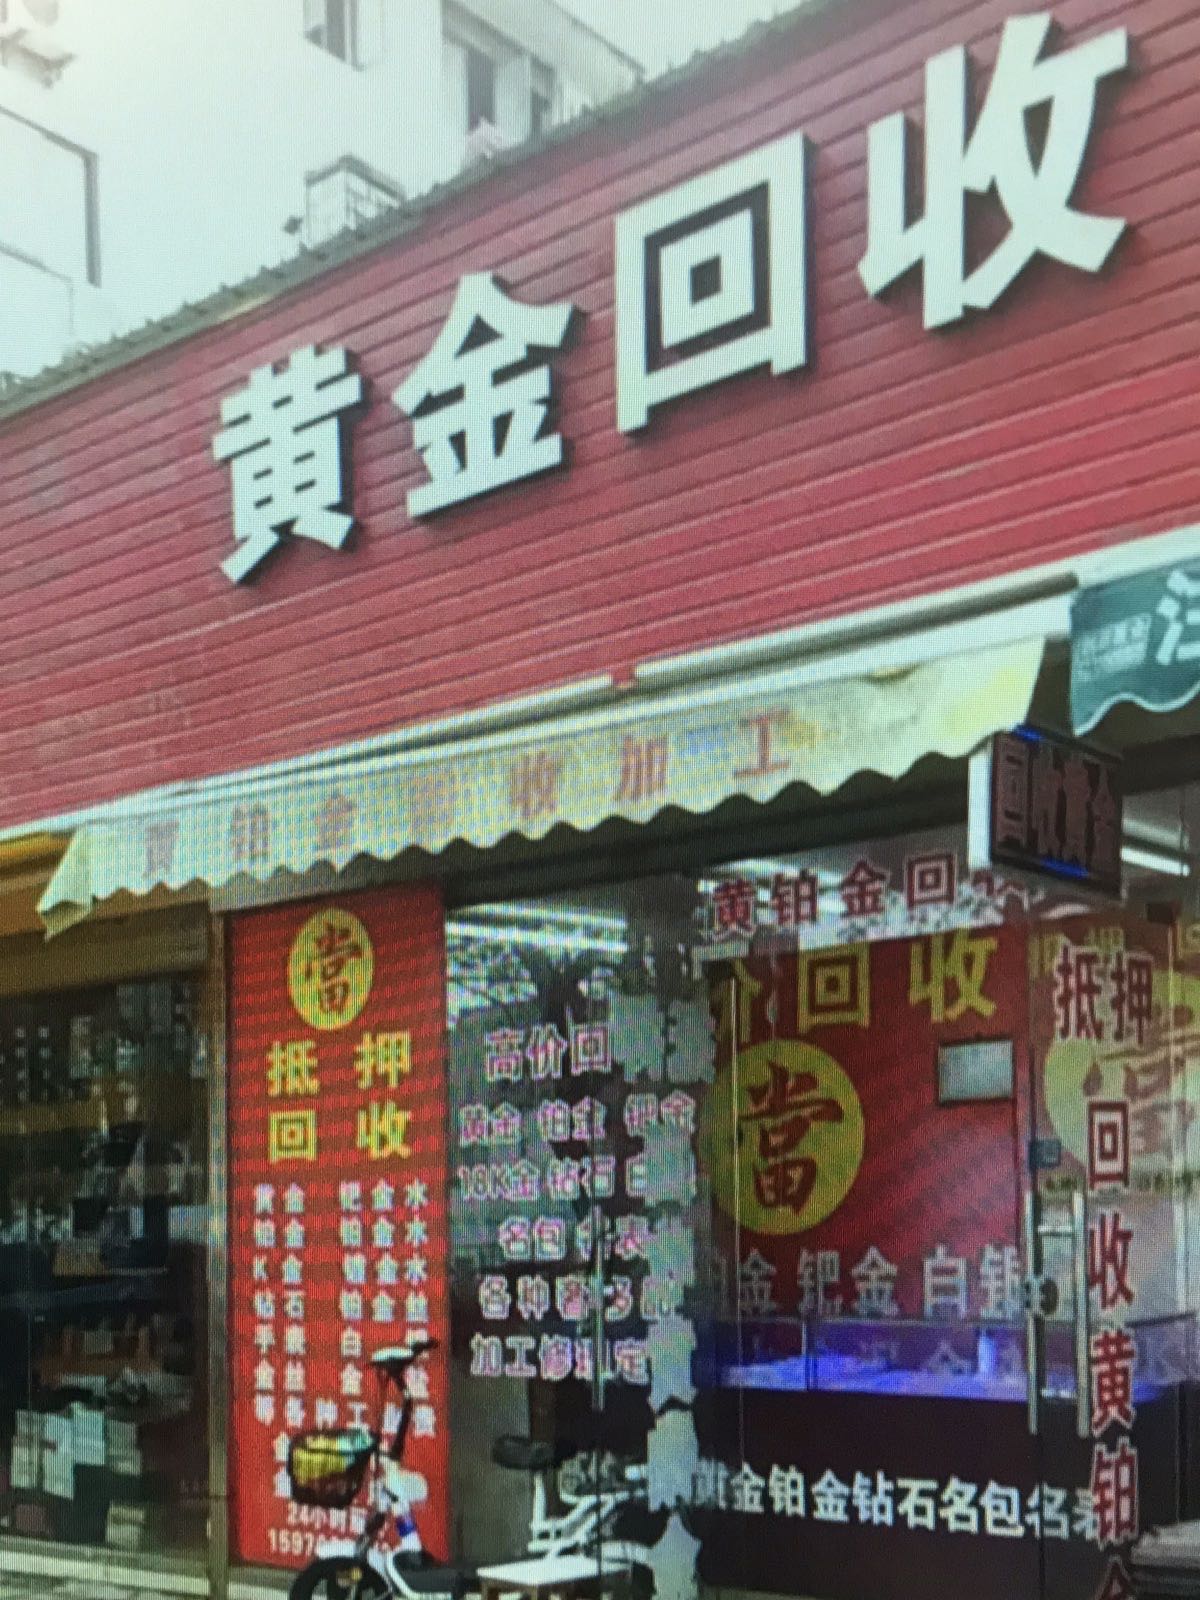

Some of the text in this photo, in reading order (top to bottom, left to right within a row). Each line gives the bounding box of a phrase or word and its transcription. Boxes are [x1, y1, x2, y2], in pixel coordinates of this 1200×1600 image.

[211, 12, 1128, 583] 黄金回收
[1053, 942, 1154, 1044] 抵押
[266, 1032, 413, 1097] 抵押
[267, 1100, 412, 1164] 回收
